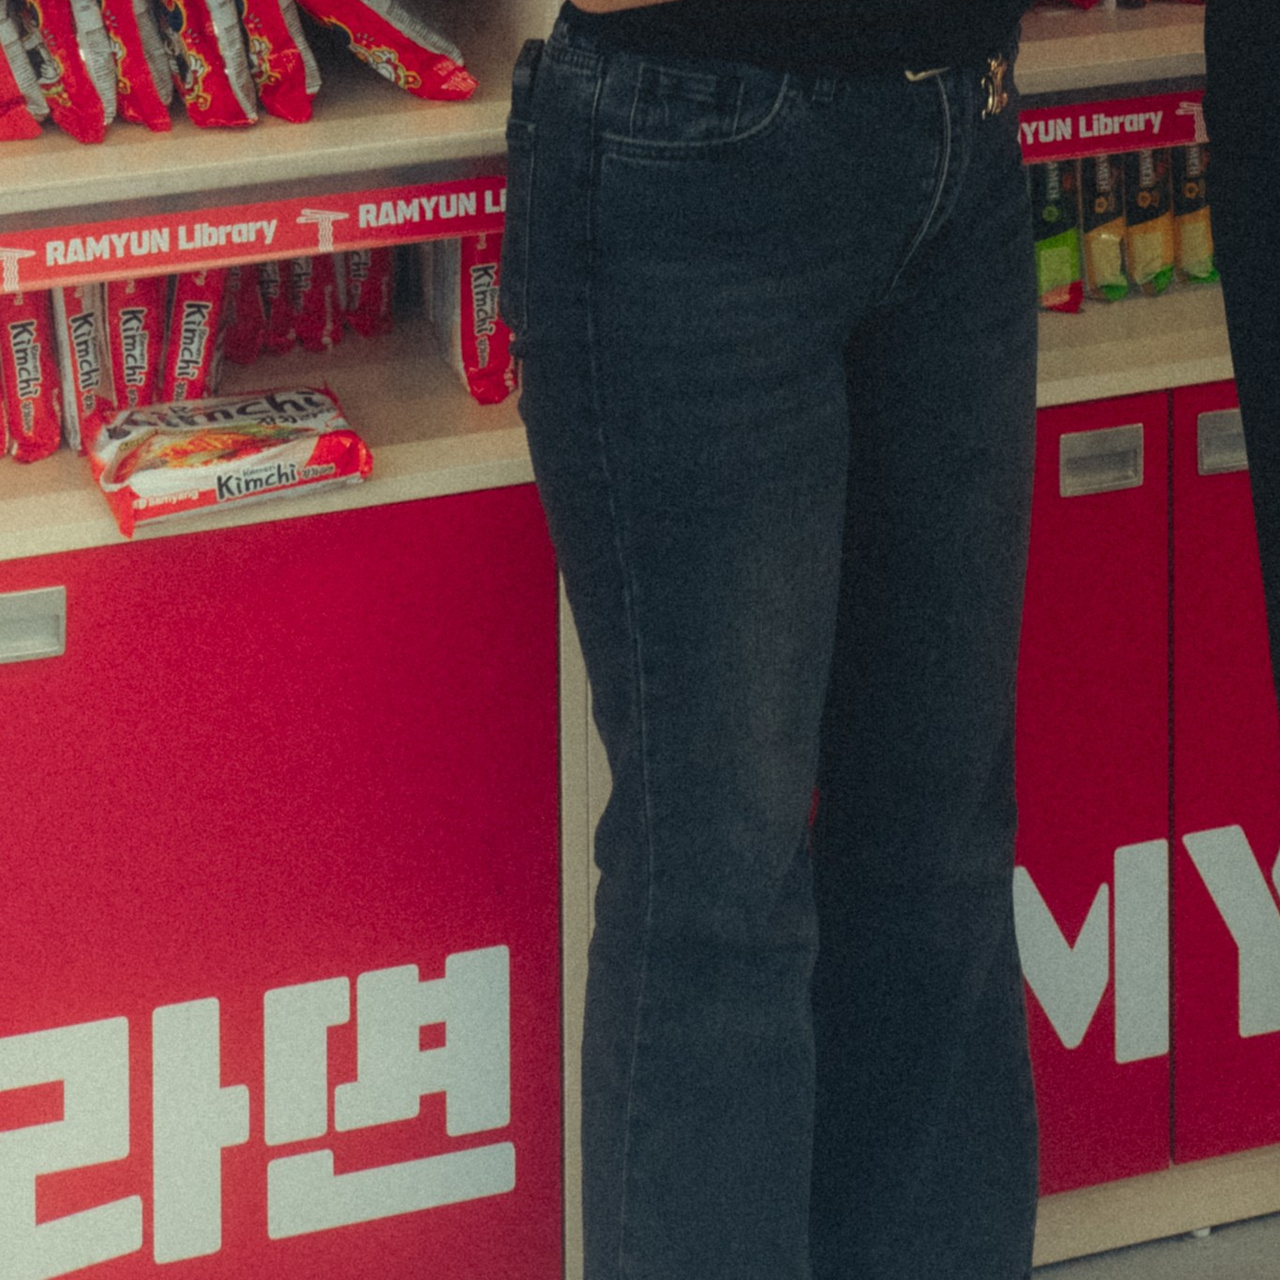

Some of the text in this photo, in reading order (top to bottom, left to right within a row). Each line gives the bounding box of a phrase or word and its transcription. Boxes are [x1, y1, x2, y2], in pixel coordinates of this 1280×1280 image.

[1079, 112, 1162, 138] Library
[46, 220, 277, 266] RAMYUN Library
[358, 192, 477, 228] RAMYUN
[469, 262, 498, 337] Kimchi
[9, 319, 41, 399] Kimchi
[69, 310, 101, 391] Kimchi
[120, 307, 147, 386] Kimchi
[176, 300, 212, 380] Kimchi
[215, 463, 298, 502] Kimchi
[0, 944, 517, 1278] 라면
